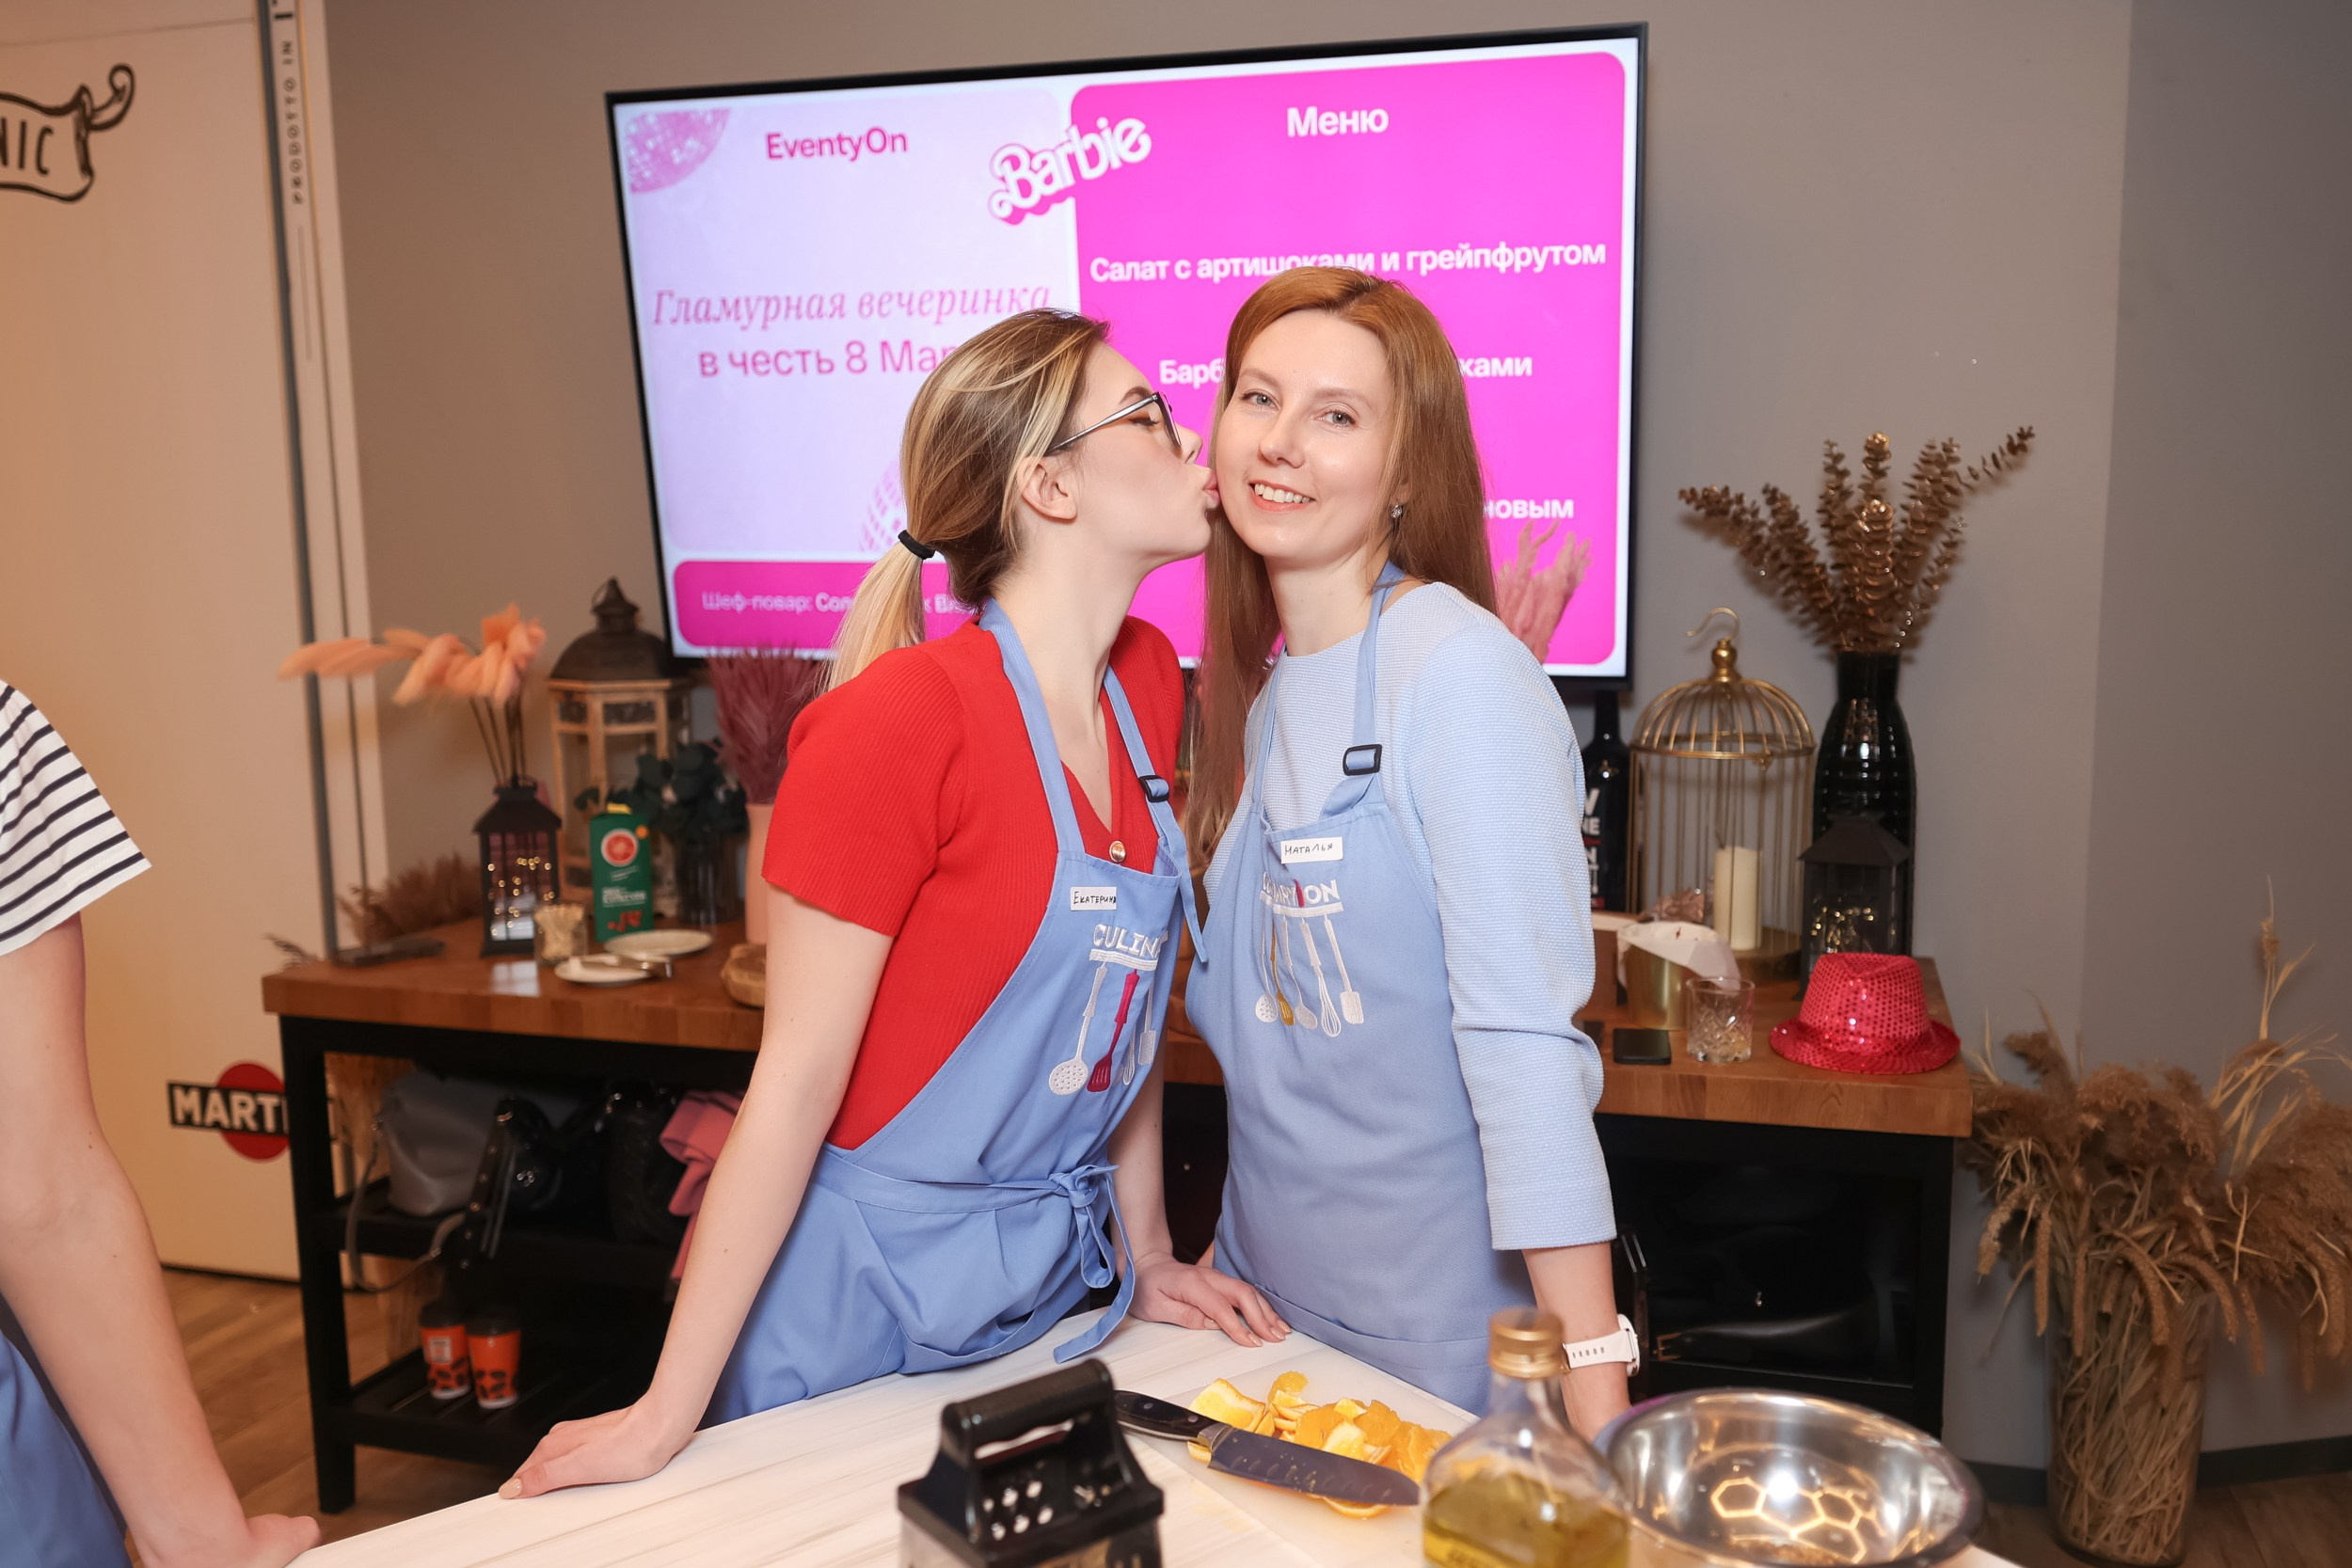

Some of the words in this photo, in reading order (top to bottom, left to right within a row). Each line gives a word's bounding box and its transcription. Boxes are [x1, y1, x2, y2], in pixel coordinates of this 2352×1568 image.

[1286, 105, 1390, 138] Меню
[767, 126, 909, 163] EventyOn
[989, 117, 1152, 222] Barbie
[1089, 256, 1169, 283] Салат
[1173, 261, 1192, 280] с
[1380, 250, 1401, 273] и
[1406, 240, 1607, 277] грейпфрутом
[653, 288, 847, 332] Гламурная
[857, 283, 1051, 325] вечеринка
[697, 350, 719, 377] в
[727, 348, 835, 376] честь
[845, 339, 867, 374] 8
